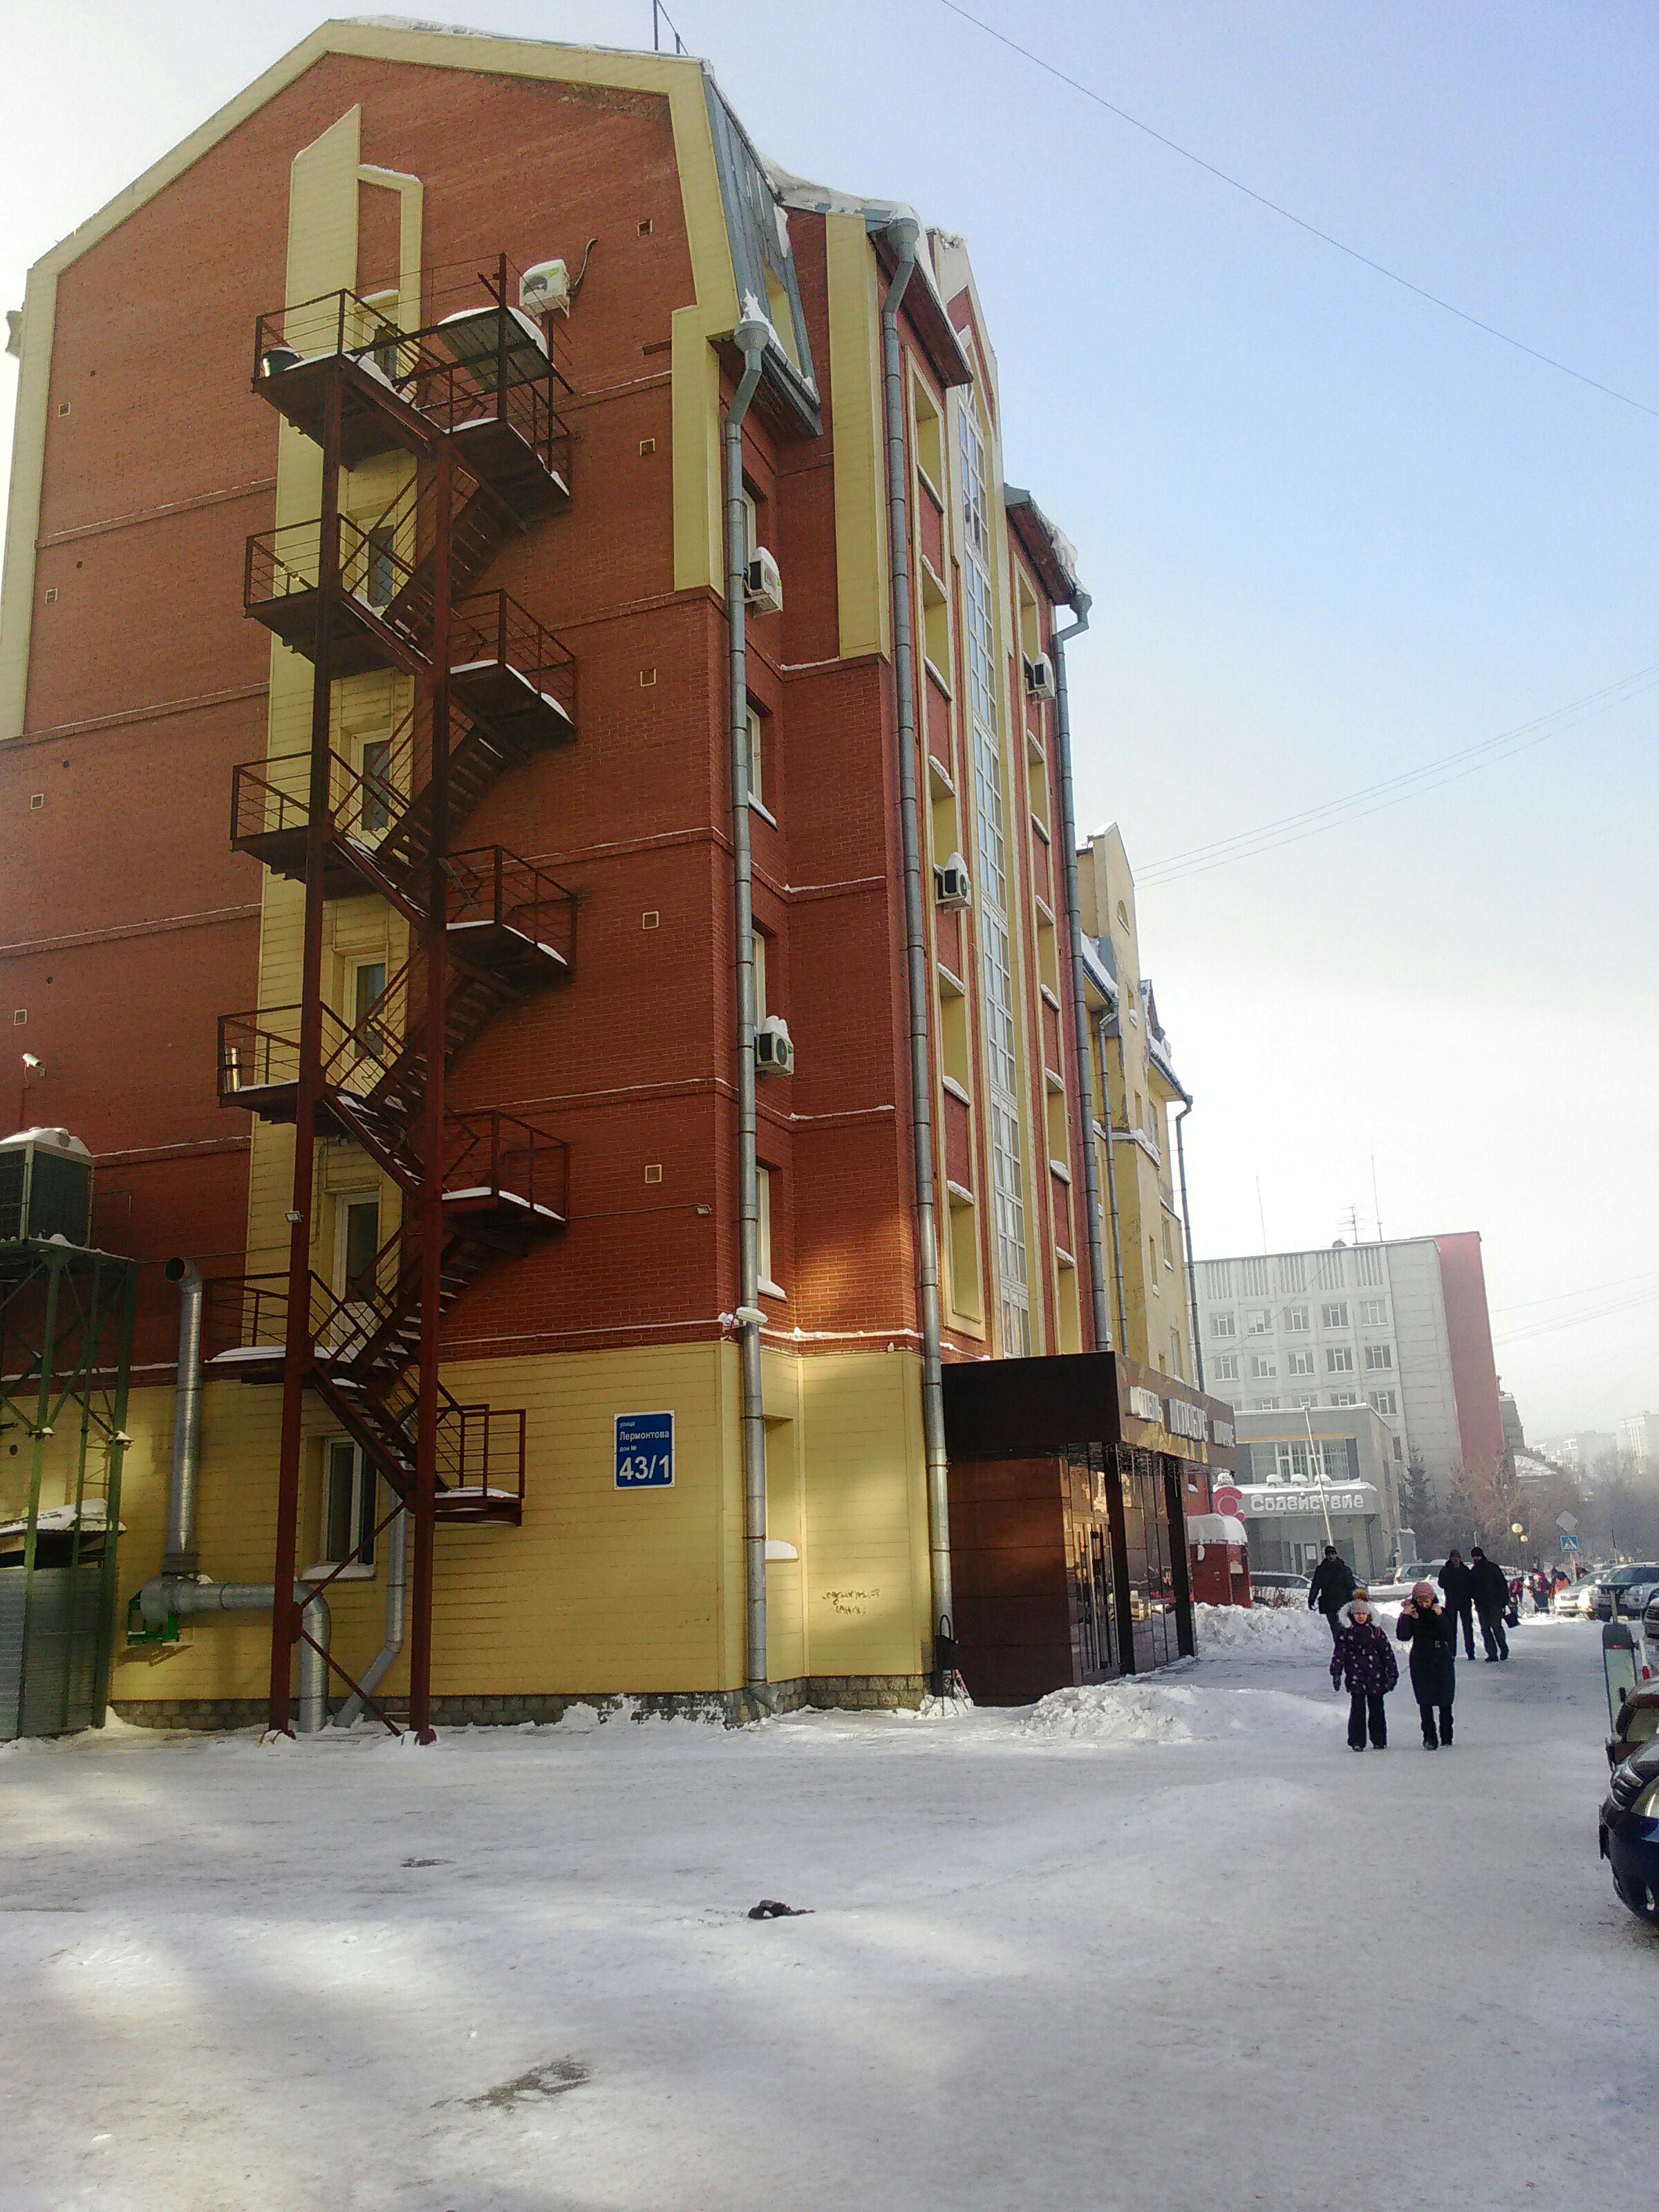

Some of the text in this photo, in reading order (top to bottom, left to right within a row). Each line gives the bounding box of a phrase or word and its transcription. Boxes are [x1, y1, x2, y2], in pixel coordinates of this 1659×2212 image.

[619, 1431, 669, 1441] Лермонтова
[619, 1455, 669, 1481] 43/1
[1250, 1493, 1365, 1512] Содействие
